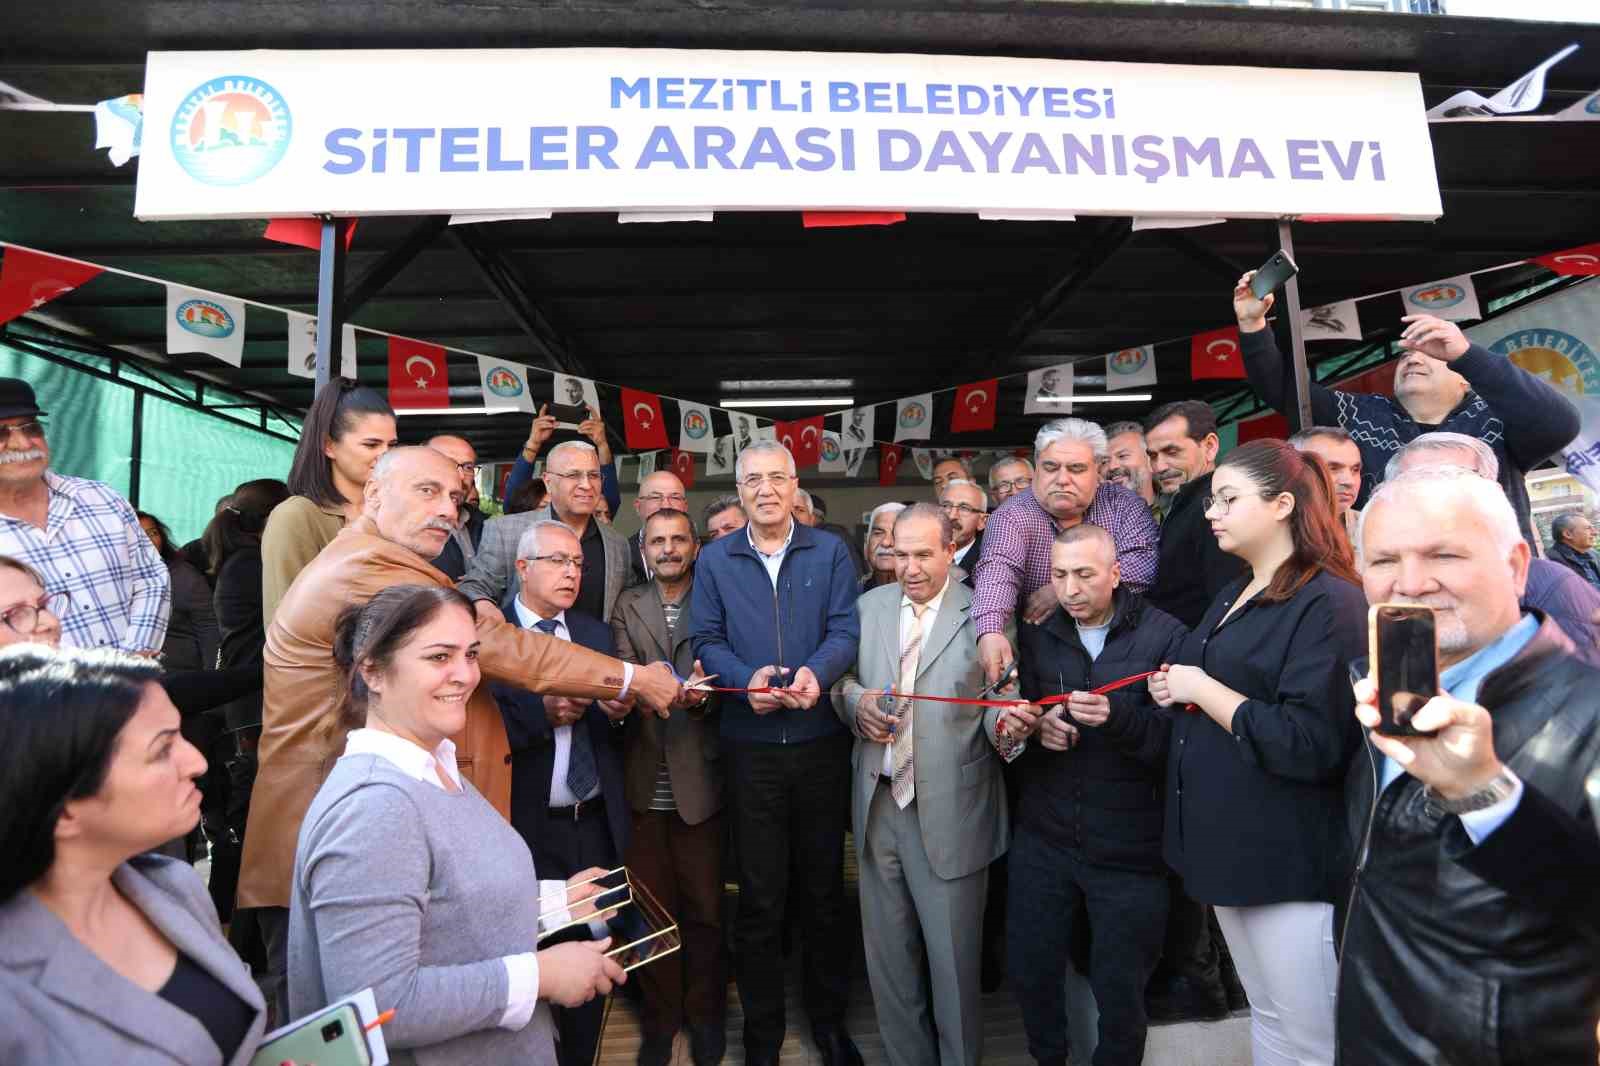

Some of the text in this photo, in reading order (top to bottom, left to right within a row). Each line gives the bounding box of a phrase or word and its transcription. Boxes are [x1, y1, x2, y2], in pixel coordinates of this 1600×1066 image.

[610, 76, 1115, 119] MEZİTLİ BELEDİYESİ
[324, 126, 1386, 183] SİTELER ARASI DAYANIŞMA EVİ
